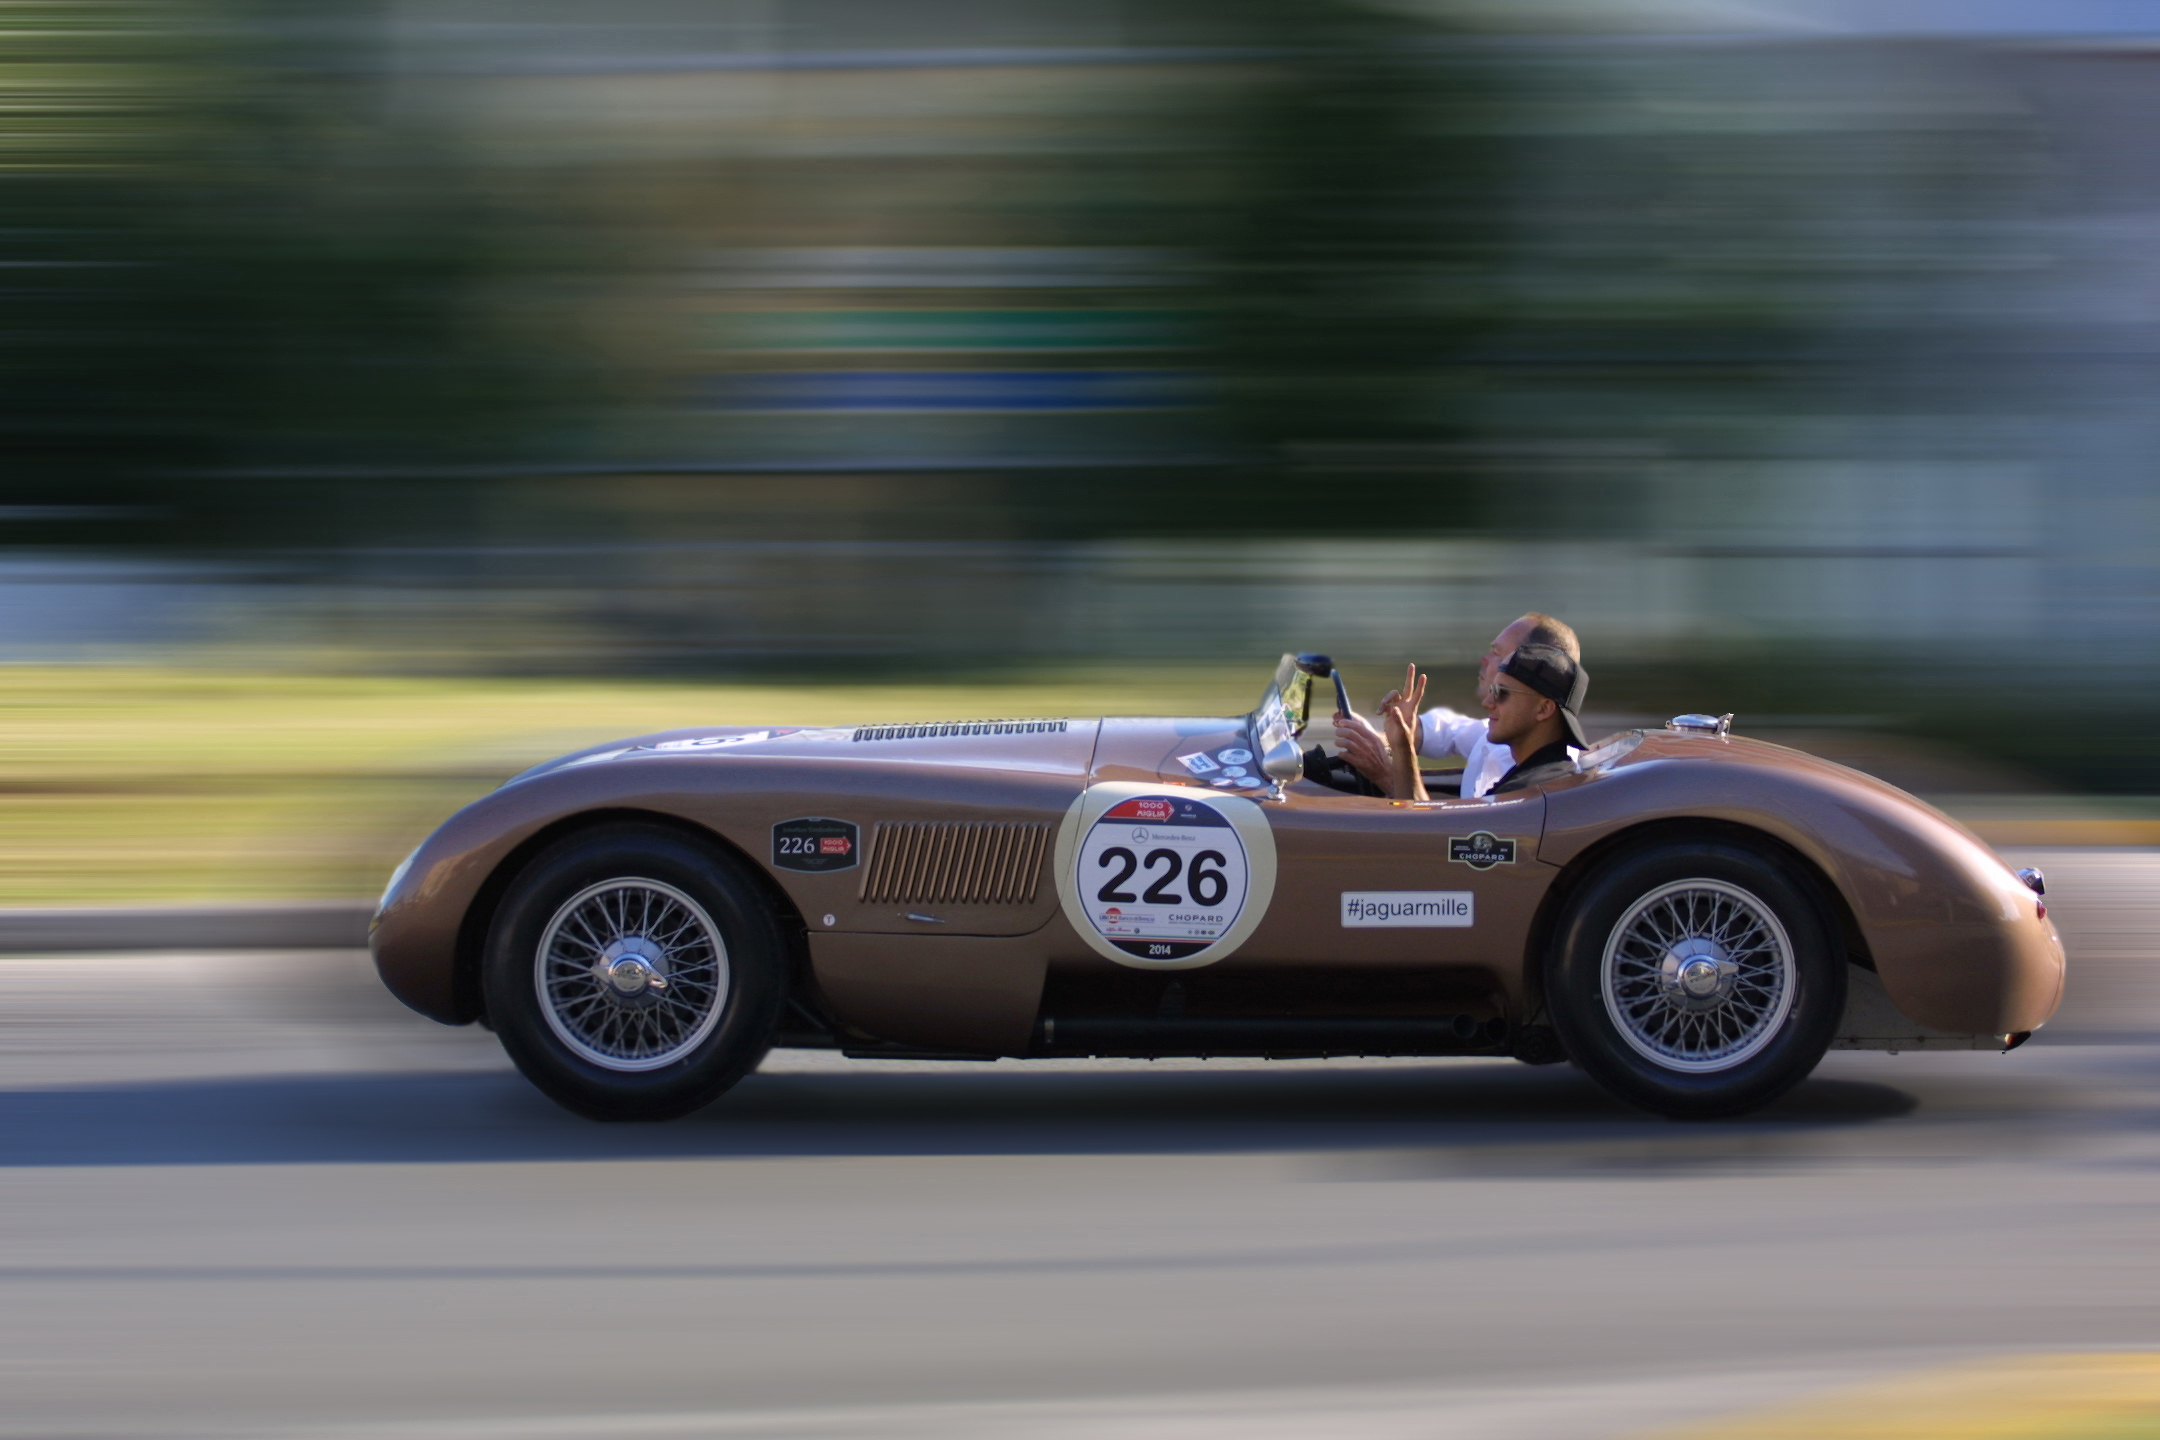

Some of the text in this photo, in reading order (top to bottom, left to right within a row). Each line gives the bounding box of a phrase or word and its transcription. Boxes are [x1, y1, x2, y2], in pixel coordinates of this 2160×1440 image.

[1138, 801, 1164, 809] 1000
[1136, 810, 1166, 818] MIGLIA
[779, 837, 815, 854] 226
[1097, 847, 1228, 907] 226
[1347, 899, 1469, 921] #jaguarmille
[1168, 914, 1224, 923] CHOPARD
[1149, 944, 1172, 956] 2014
